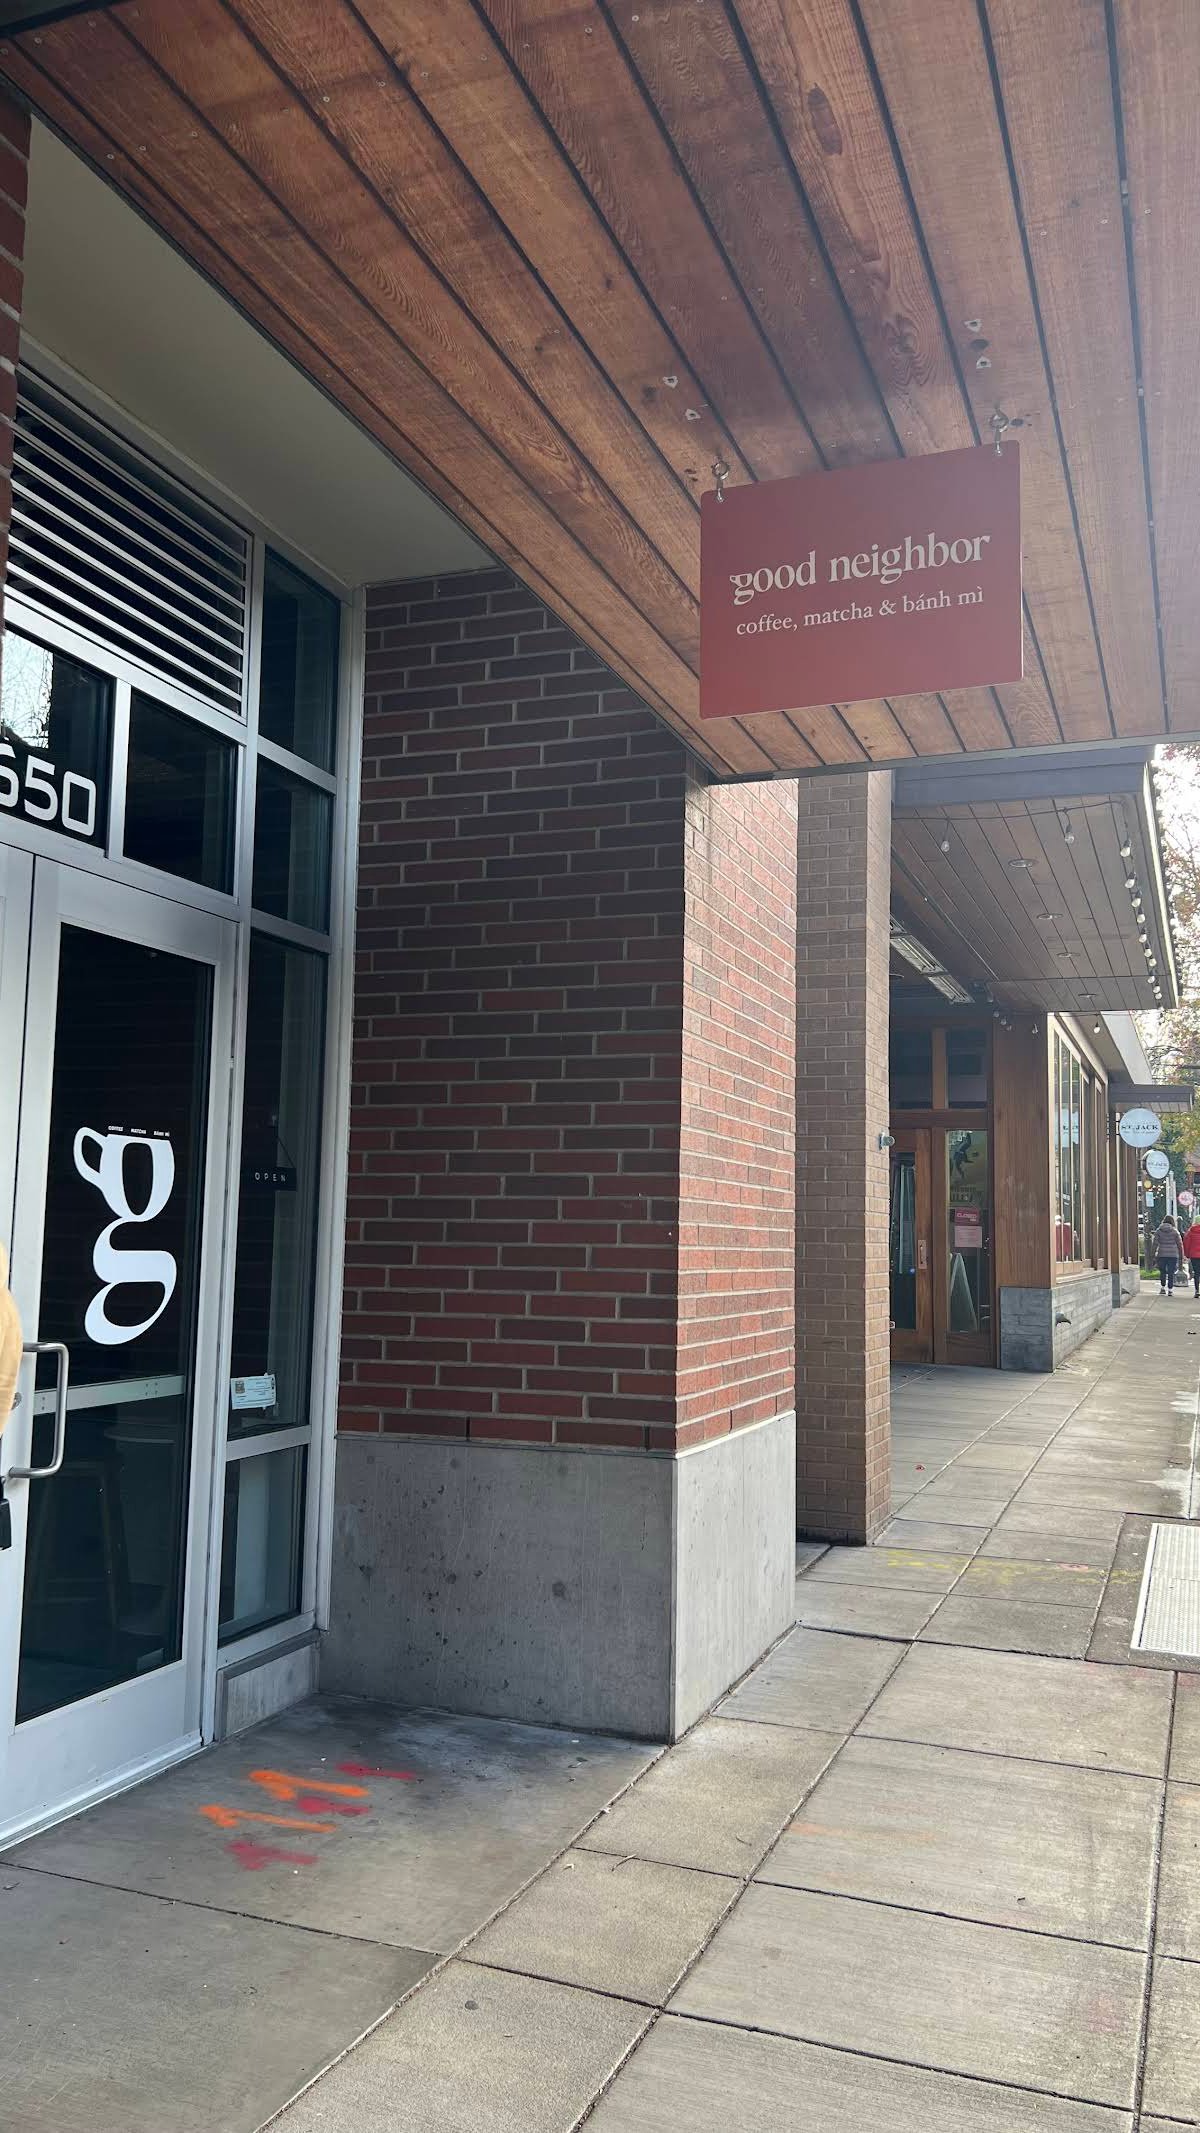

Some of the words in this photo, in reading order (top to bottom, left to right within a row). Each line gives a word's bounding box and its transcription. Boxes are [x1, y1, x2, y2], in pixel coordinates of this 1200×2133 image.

[729, 550, 817, 606] good
[828, 532, 991, 585] neighbor
[736, 613, 799, 636] coffee,
[803, 602, 874, 627] matcha
[878, 599, 897, 617] &
[902, 590, 952, 614] bánh
[957, 586, 984, 606] mì
[254, 1172, 286, 1182] OPEN
